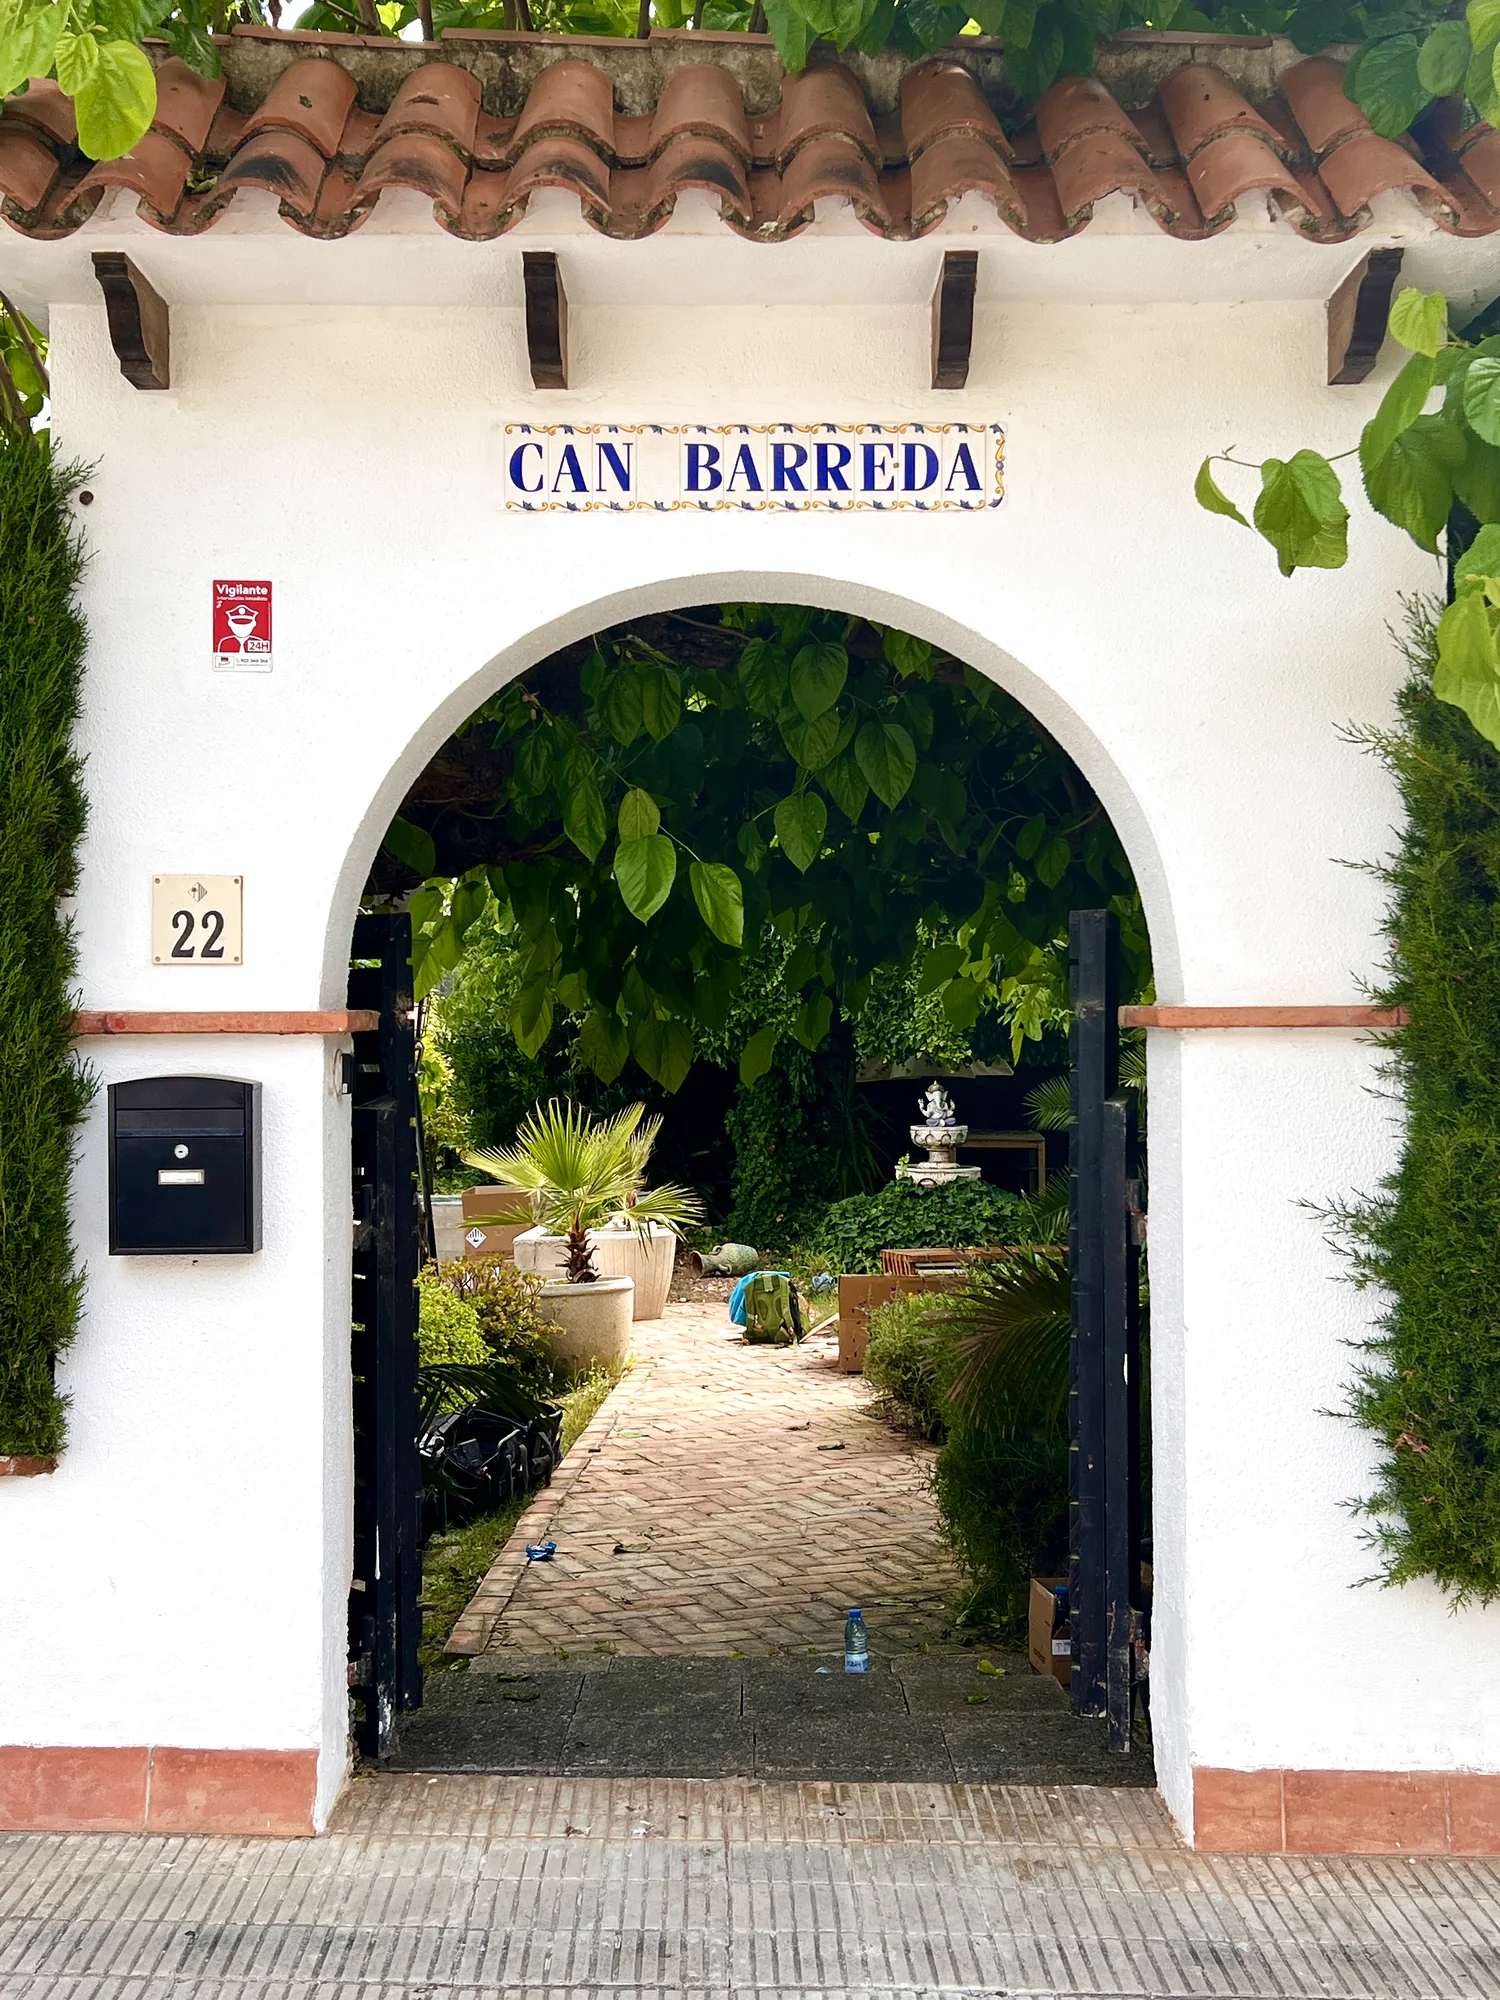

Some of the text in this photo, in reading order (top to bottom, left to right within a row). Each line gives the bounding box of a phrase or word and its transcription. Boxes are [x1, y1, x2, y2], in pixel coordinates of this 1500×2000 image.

[509, 442, 984, 493] CAN BARREDA
[216, 584, 268, 597] Vigilante
[249, 641, 269, 651] 24H
[171, 910, 225, 958] 22
